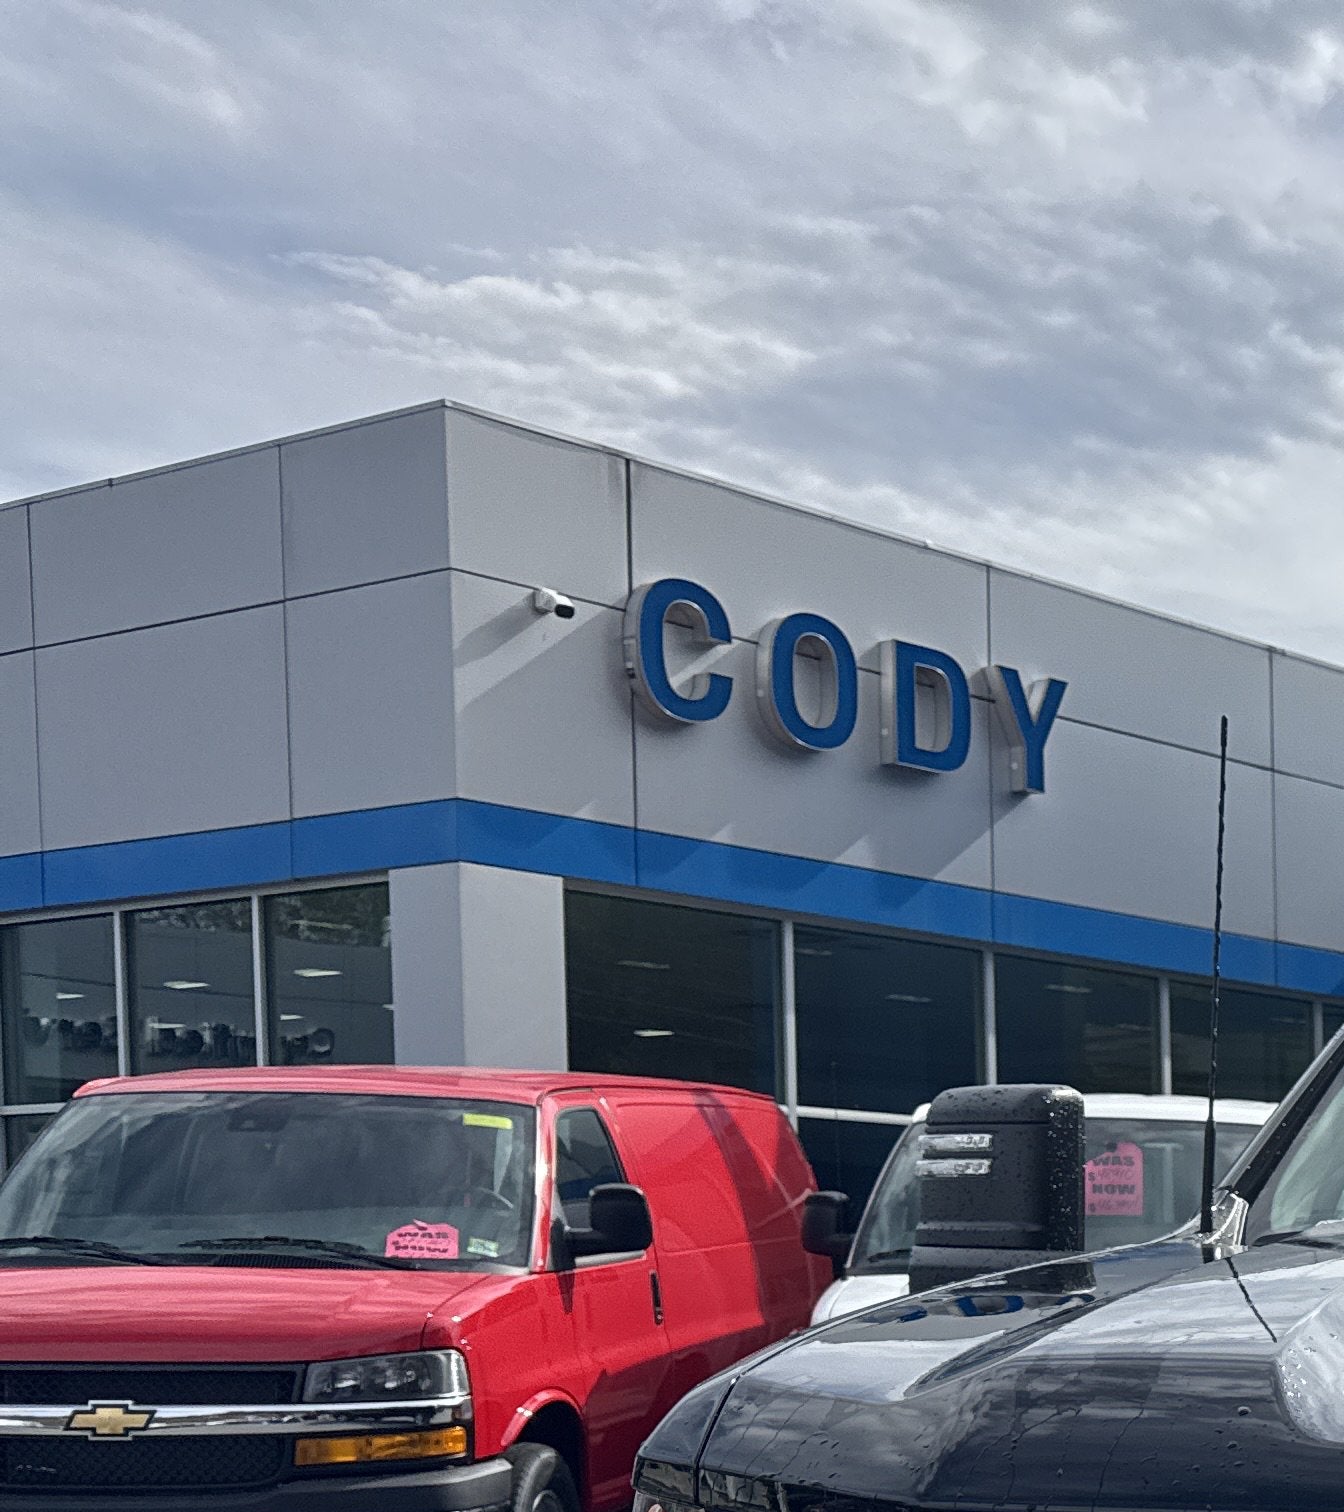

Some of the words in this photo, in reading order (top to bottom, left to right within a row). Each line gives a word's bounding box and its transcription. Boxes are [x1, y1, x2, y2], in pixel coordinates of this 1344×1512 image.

[624, 577, 1068, 794] CODY
[1093, 1156, 1135, 1167] WAS
[1092, 1184, 1136, 1195] NOW
